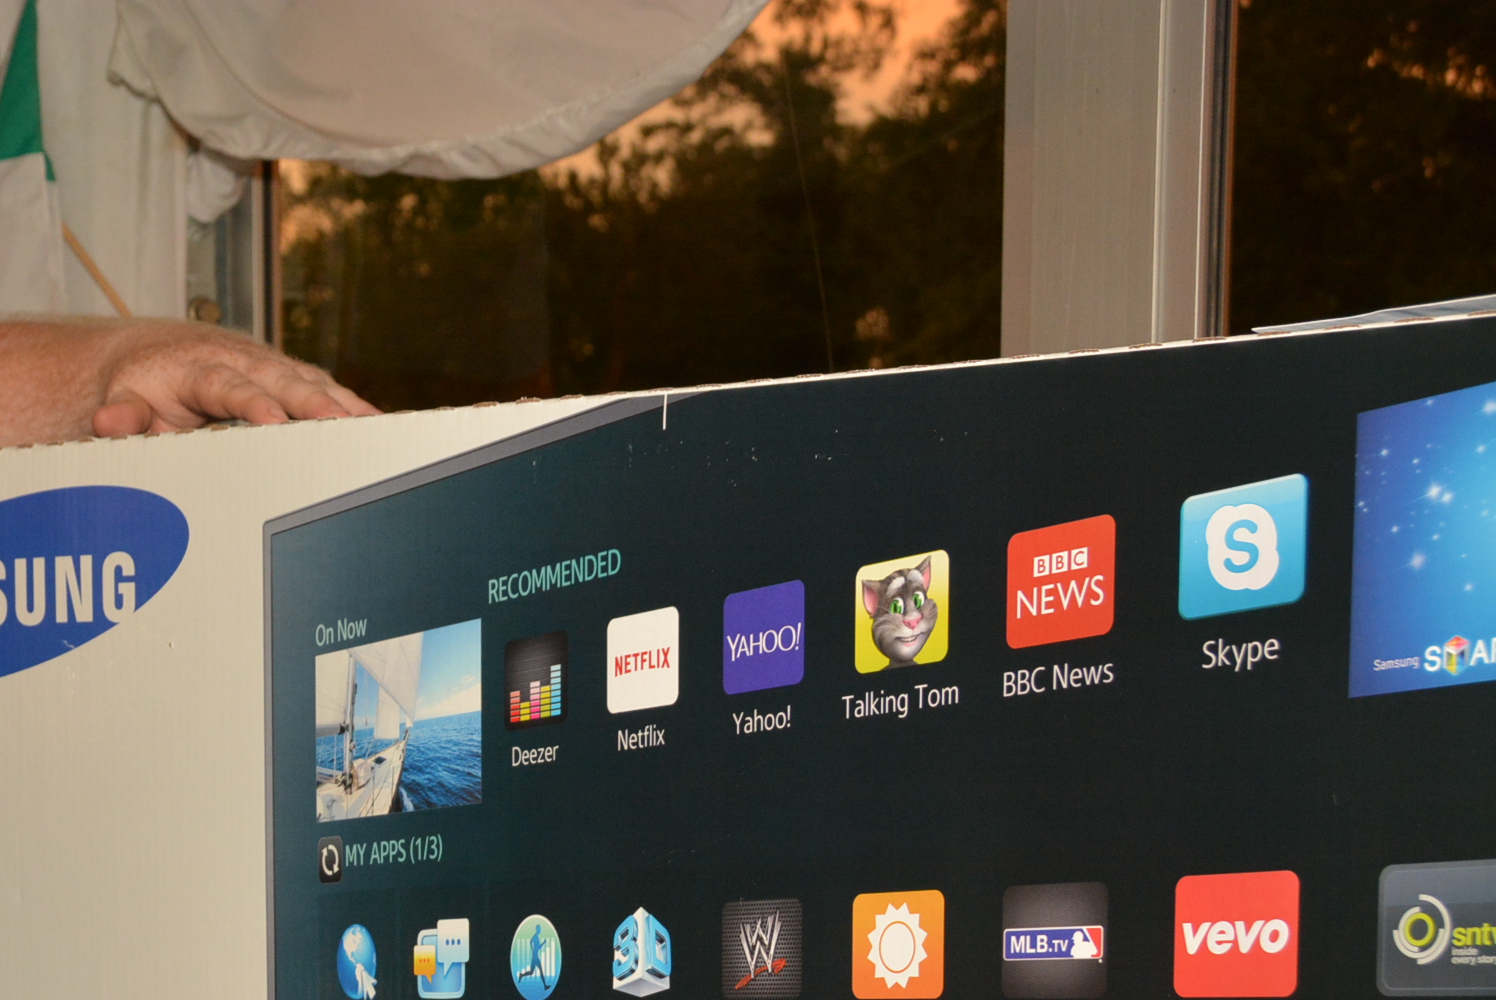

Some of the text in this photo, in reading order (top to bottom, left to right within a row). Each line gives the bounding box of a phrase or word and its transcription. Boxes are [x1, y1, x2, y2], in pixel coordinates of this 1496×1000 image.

[488, 548, 621, 604] RECOMMENDED
[1034, 547, 1088, 577] BBC
[1016, 575, 1105, 619] NEWS
[316, 618, 367, 647] On Now
[727, 623, 801, 661] YAHOO!
[615, 647, 670, 677] NETFLIX
[1202, 639, 1280, 672] Skype
[1374, 635, 1496, 675] Samsung SMA
[1003, 663, 1114, 697] BBC News
[842, 683, 959, 719] Talking Tom
[733, 706, 791, 734] Yahoo!
[618, 725, 665, 751] Netflix
[512, 744, 559, 766] Deezer
[345, 833, 443, 866] MY APPS (1/3)
[1010, 934, 1068, 954] MLB.TV
[1182, 919, 1289, 955] vevo
